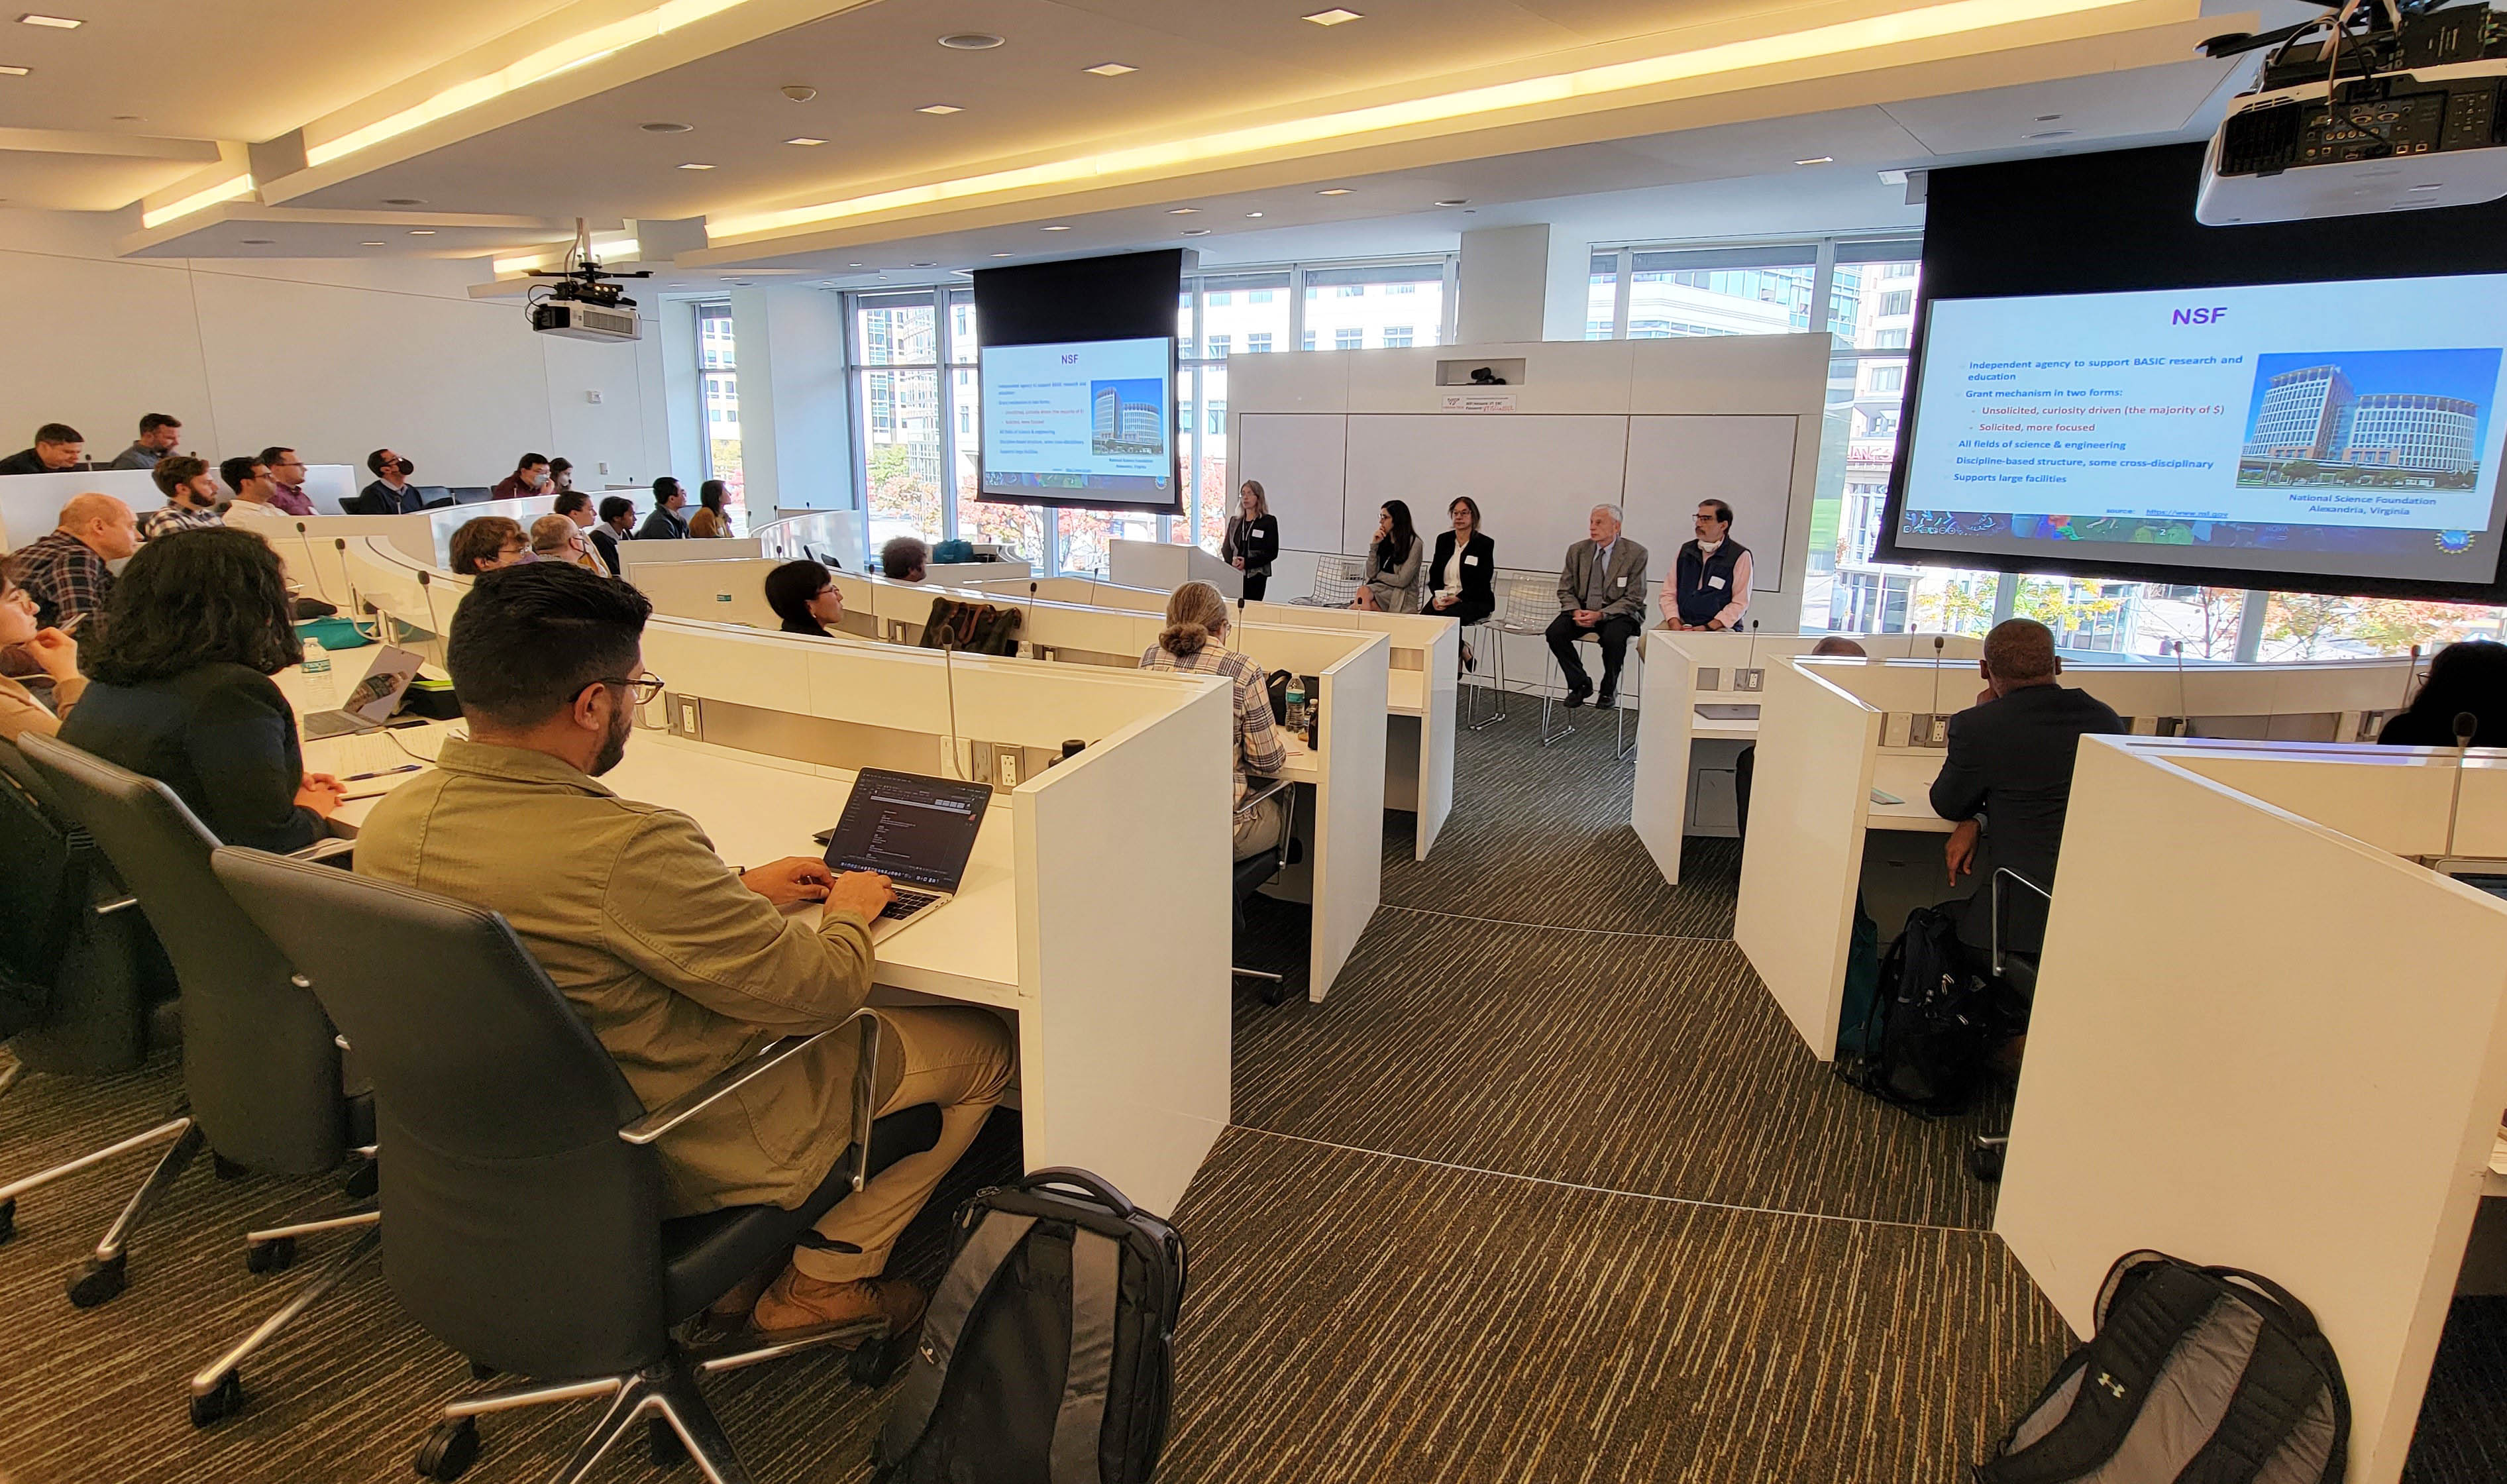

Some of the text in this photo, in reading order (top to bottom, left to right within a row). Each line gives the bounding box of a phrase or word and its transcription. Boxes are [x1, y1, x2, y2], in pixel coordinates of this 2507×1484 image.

[2172, 307, 2229, 325] NSF
[1061, 354, 1079, 364] NSF
[1969, 361, 2032, 370] Independent
[2035, 360, 2070, 370] agency
[2089, 358, 2130, 368] support
[2133, 357, 2166, 366] BASIC
[2169, 356, 2217, 365] research
[2221, 355, 2243, 364] and
[1968, 372, 2016, 382] education
[1995, 389, 2052, 398] mechanism
[2054, 388, 2064, 398] in
[2089, 388, 2123, 397] forms:
[1982, 405, 2225, 416] Unsolicited, curiosity driven (the majority of $)
[1978, 423, 2023, 433] Solicited,
[2055, 423, 2096, 432] focused
[1974, 440, 2000, 449] fields
[2002, 440, 2013, 449] of
[2014, 440, 2051, 449] science
[2064, 441, 2127, 450] engineering
[1956, 456, 2035, 466] Discipline-based
[2037, 458, 2086, 467] structure,
[2119, 459, 2214, 470] cross-disciplinary
[1953, 473, 2067, 484] Supports large facilities
[2288, 494, 2437, 505] National Science Foundation
[2308, 505, 2410, 516] Alexandria, Virginia
